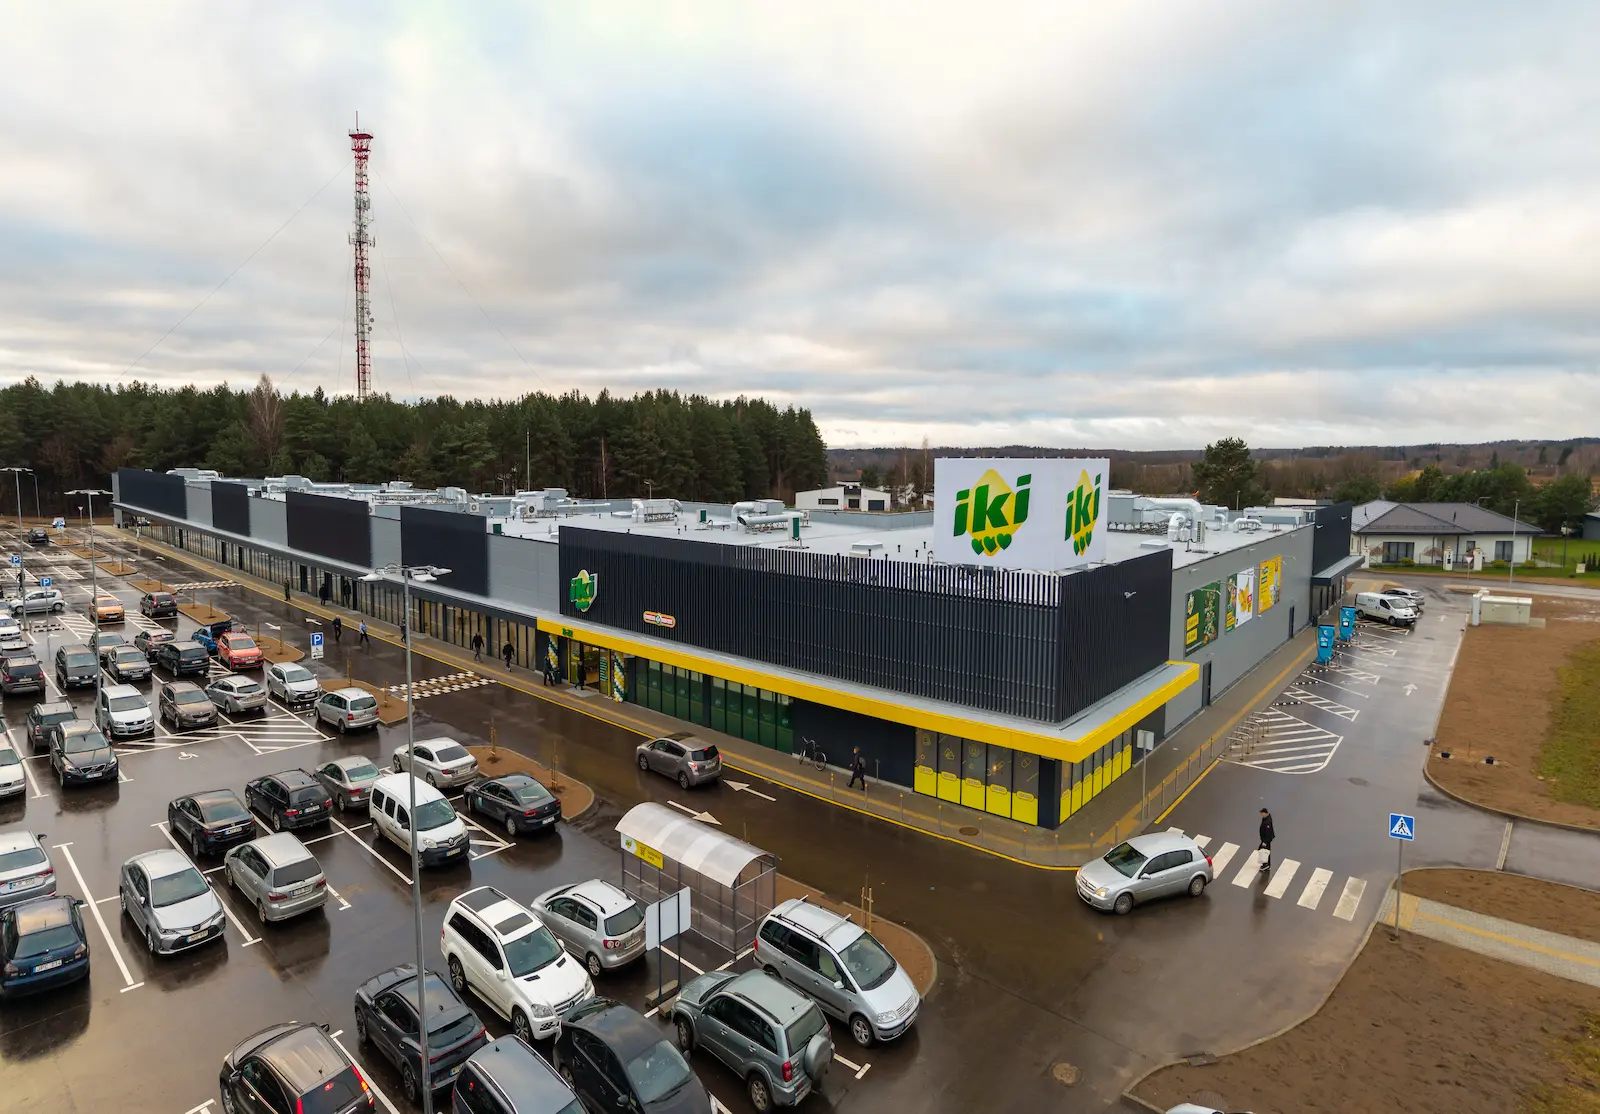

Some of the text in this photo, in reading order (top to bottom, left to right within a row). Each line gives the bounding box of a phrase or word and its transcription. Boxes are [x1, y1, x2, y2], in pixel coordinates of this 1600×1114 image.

[953, 473, 1032, 537] iki
[1064, 473, 1101, 541] iki
[570, 576, 595, 602] iki
[315, 635, 321, 645] P
